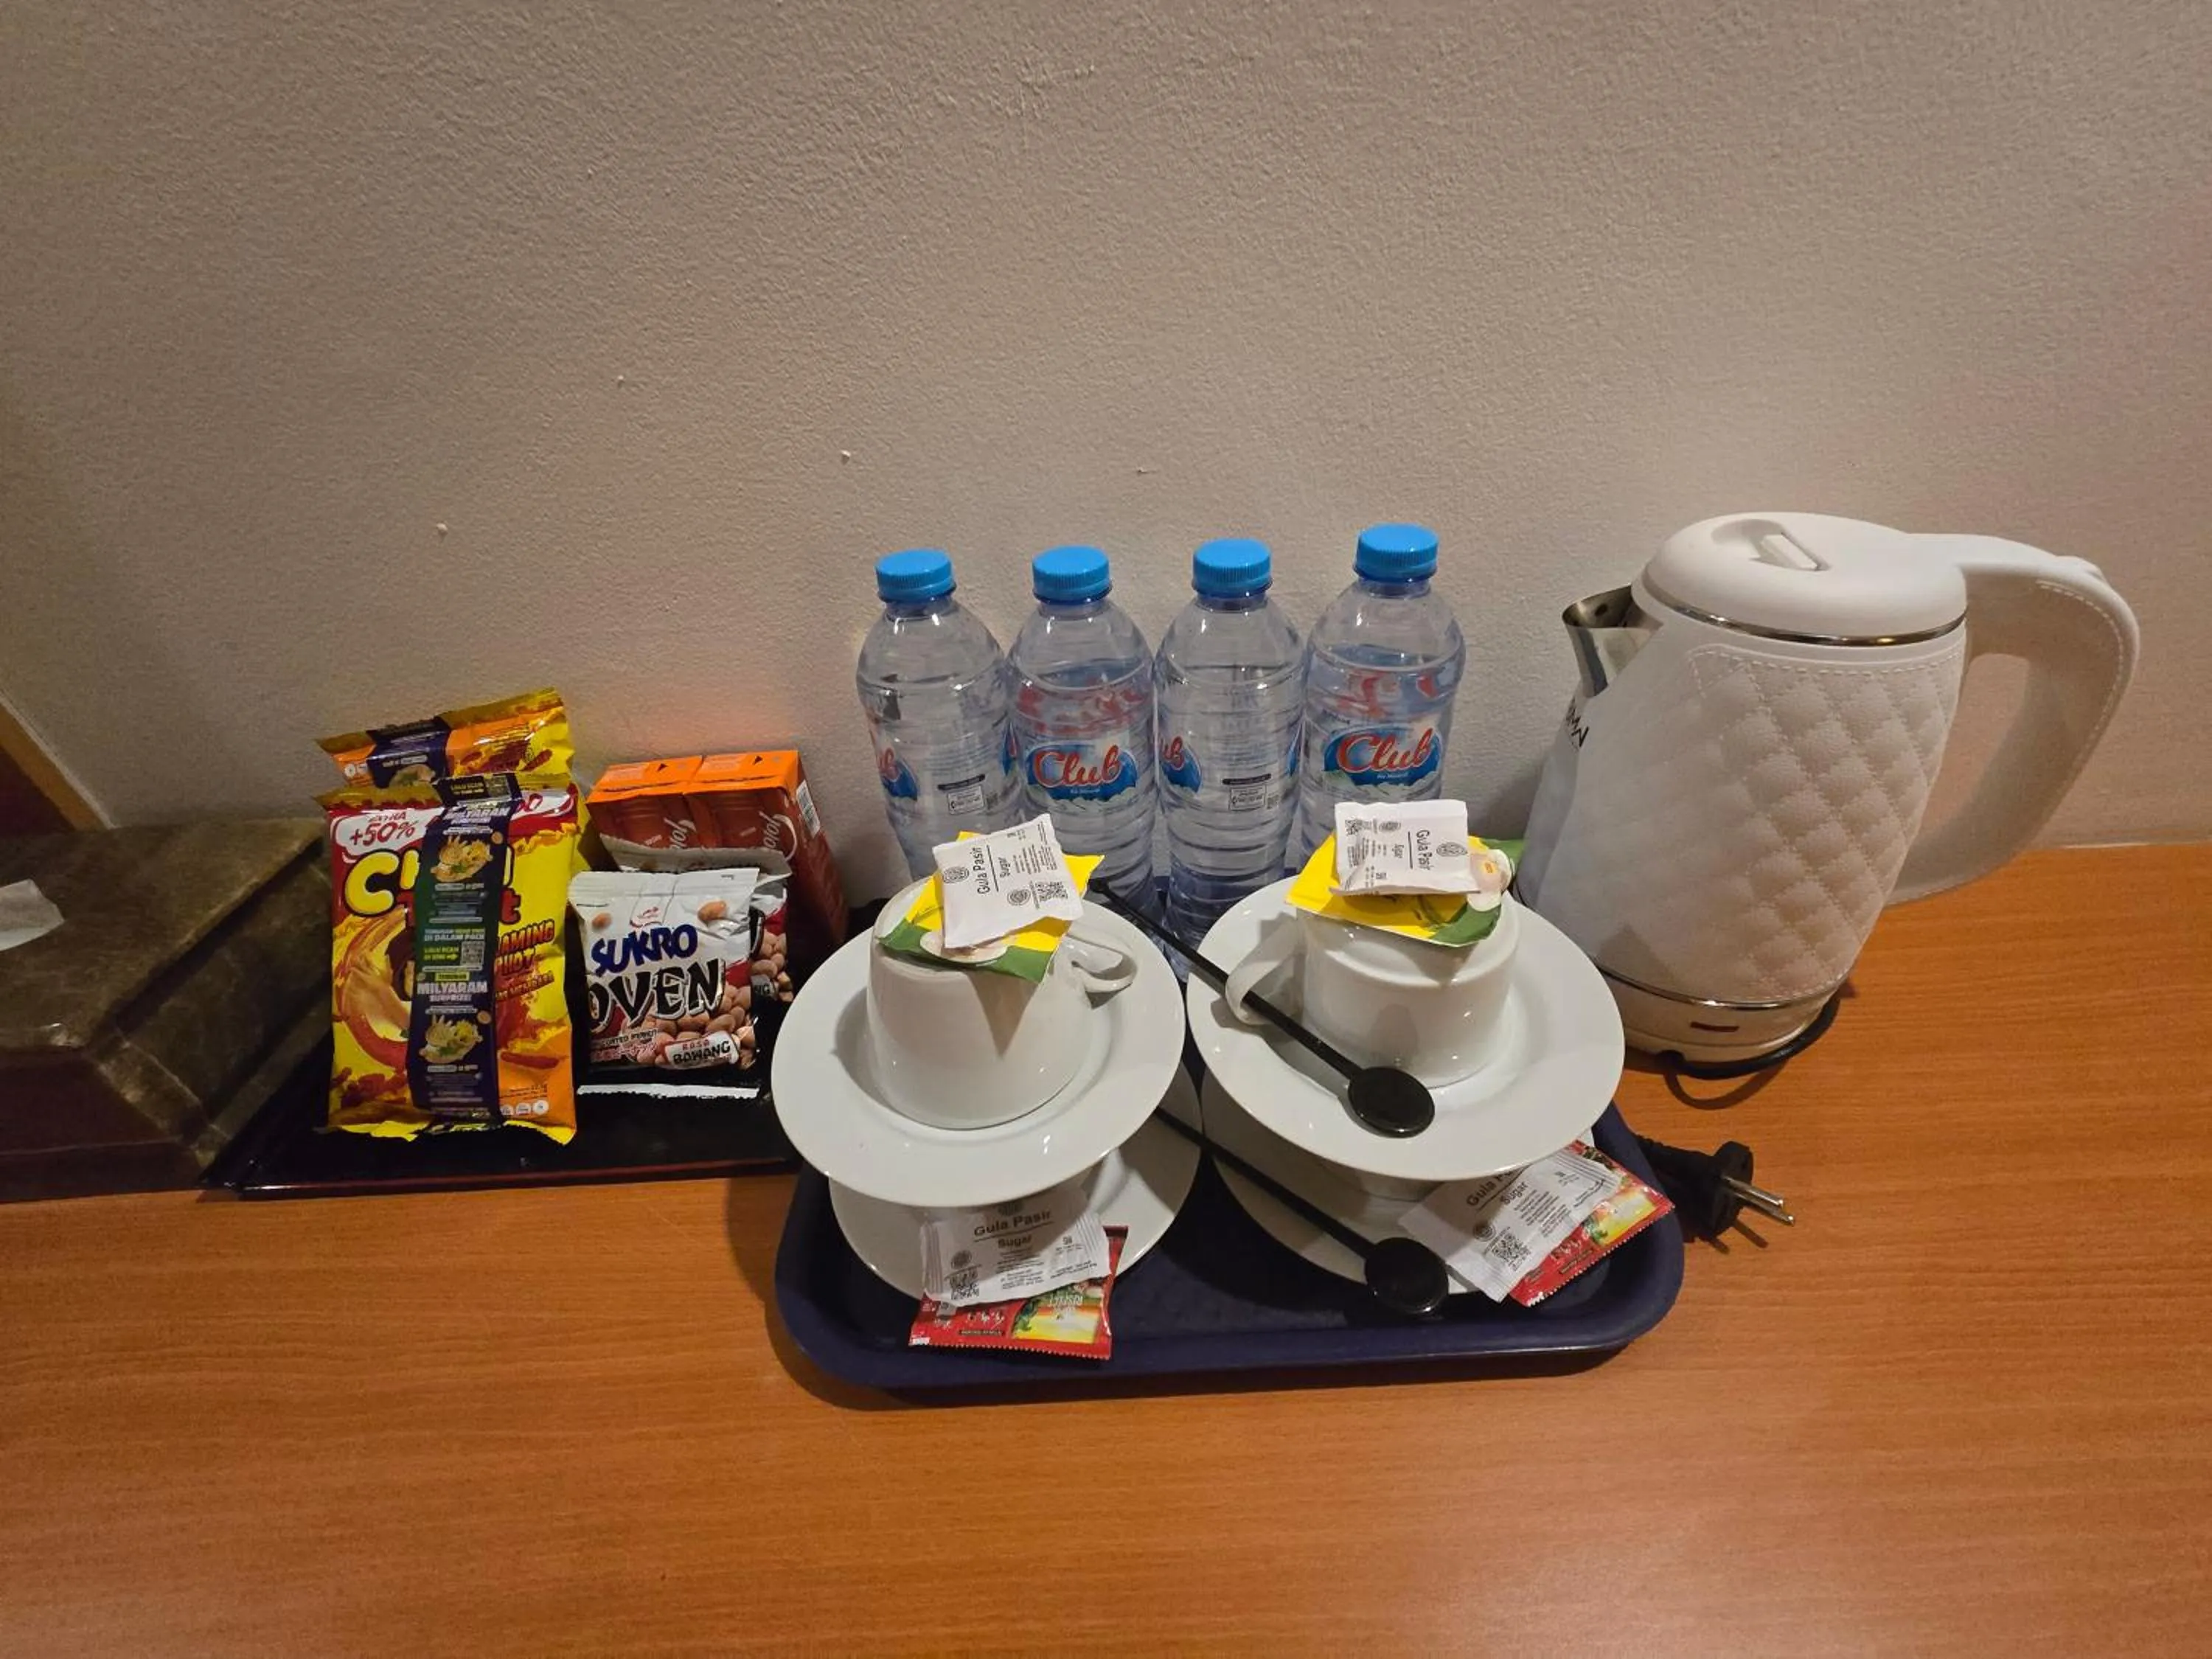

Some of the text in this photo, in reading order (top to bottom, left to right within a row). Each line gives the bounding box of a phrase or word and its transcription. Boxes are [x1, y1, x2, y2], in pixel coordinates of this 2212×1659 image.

[1338, 727, 1434, 773] Club
[1033, 745, 1122, 787] Club
[349, 819, 418, 846] +50%
[970, 847, 991, 894] Gula Pasir
[998, 857, 1012, 878] Sugar
[591, 924, 698, 977] SUKRO
[417, 980, 487, 995] MILYARAN
[588, 959, 726, 1032] OVEN
[672, 1040, 731, 1065] BAWANG
[1467, 1180, 1497, 1206] Gula
[1500, 1182, 1528, 1205] Sugar
[974, 1210, 1052, 1237] Gula Pasir
[998, 1235, 1032, 1249] Sugar
